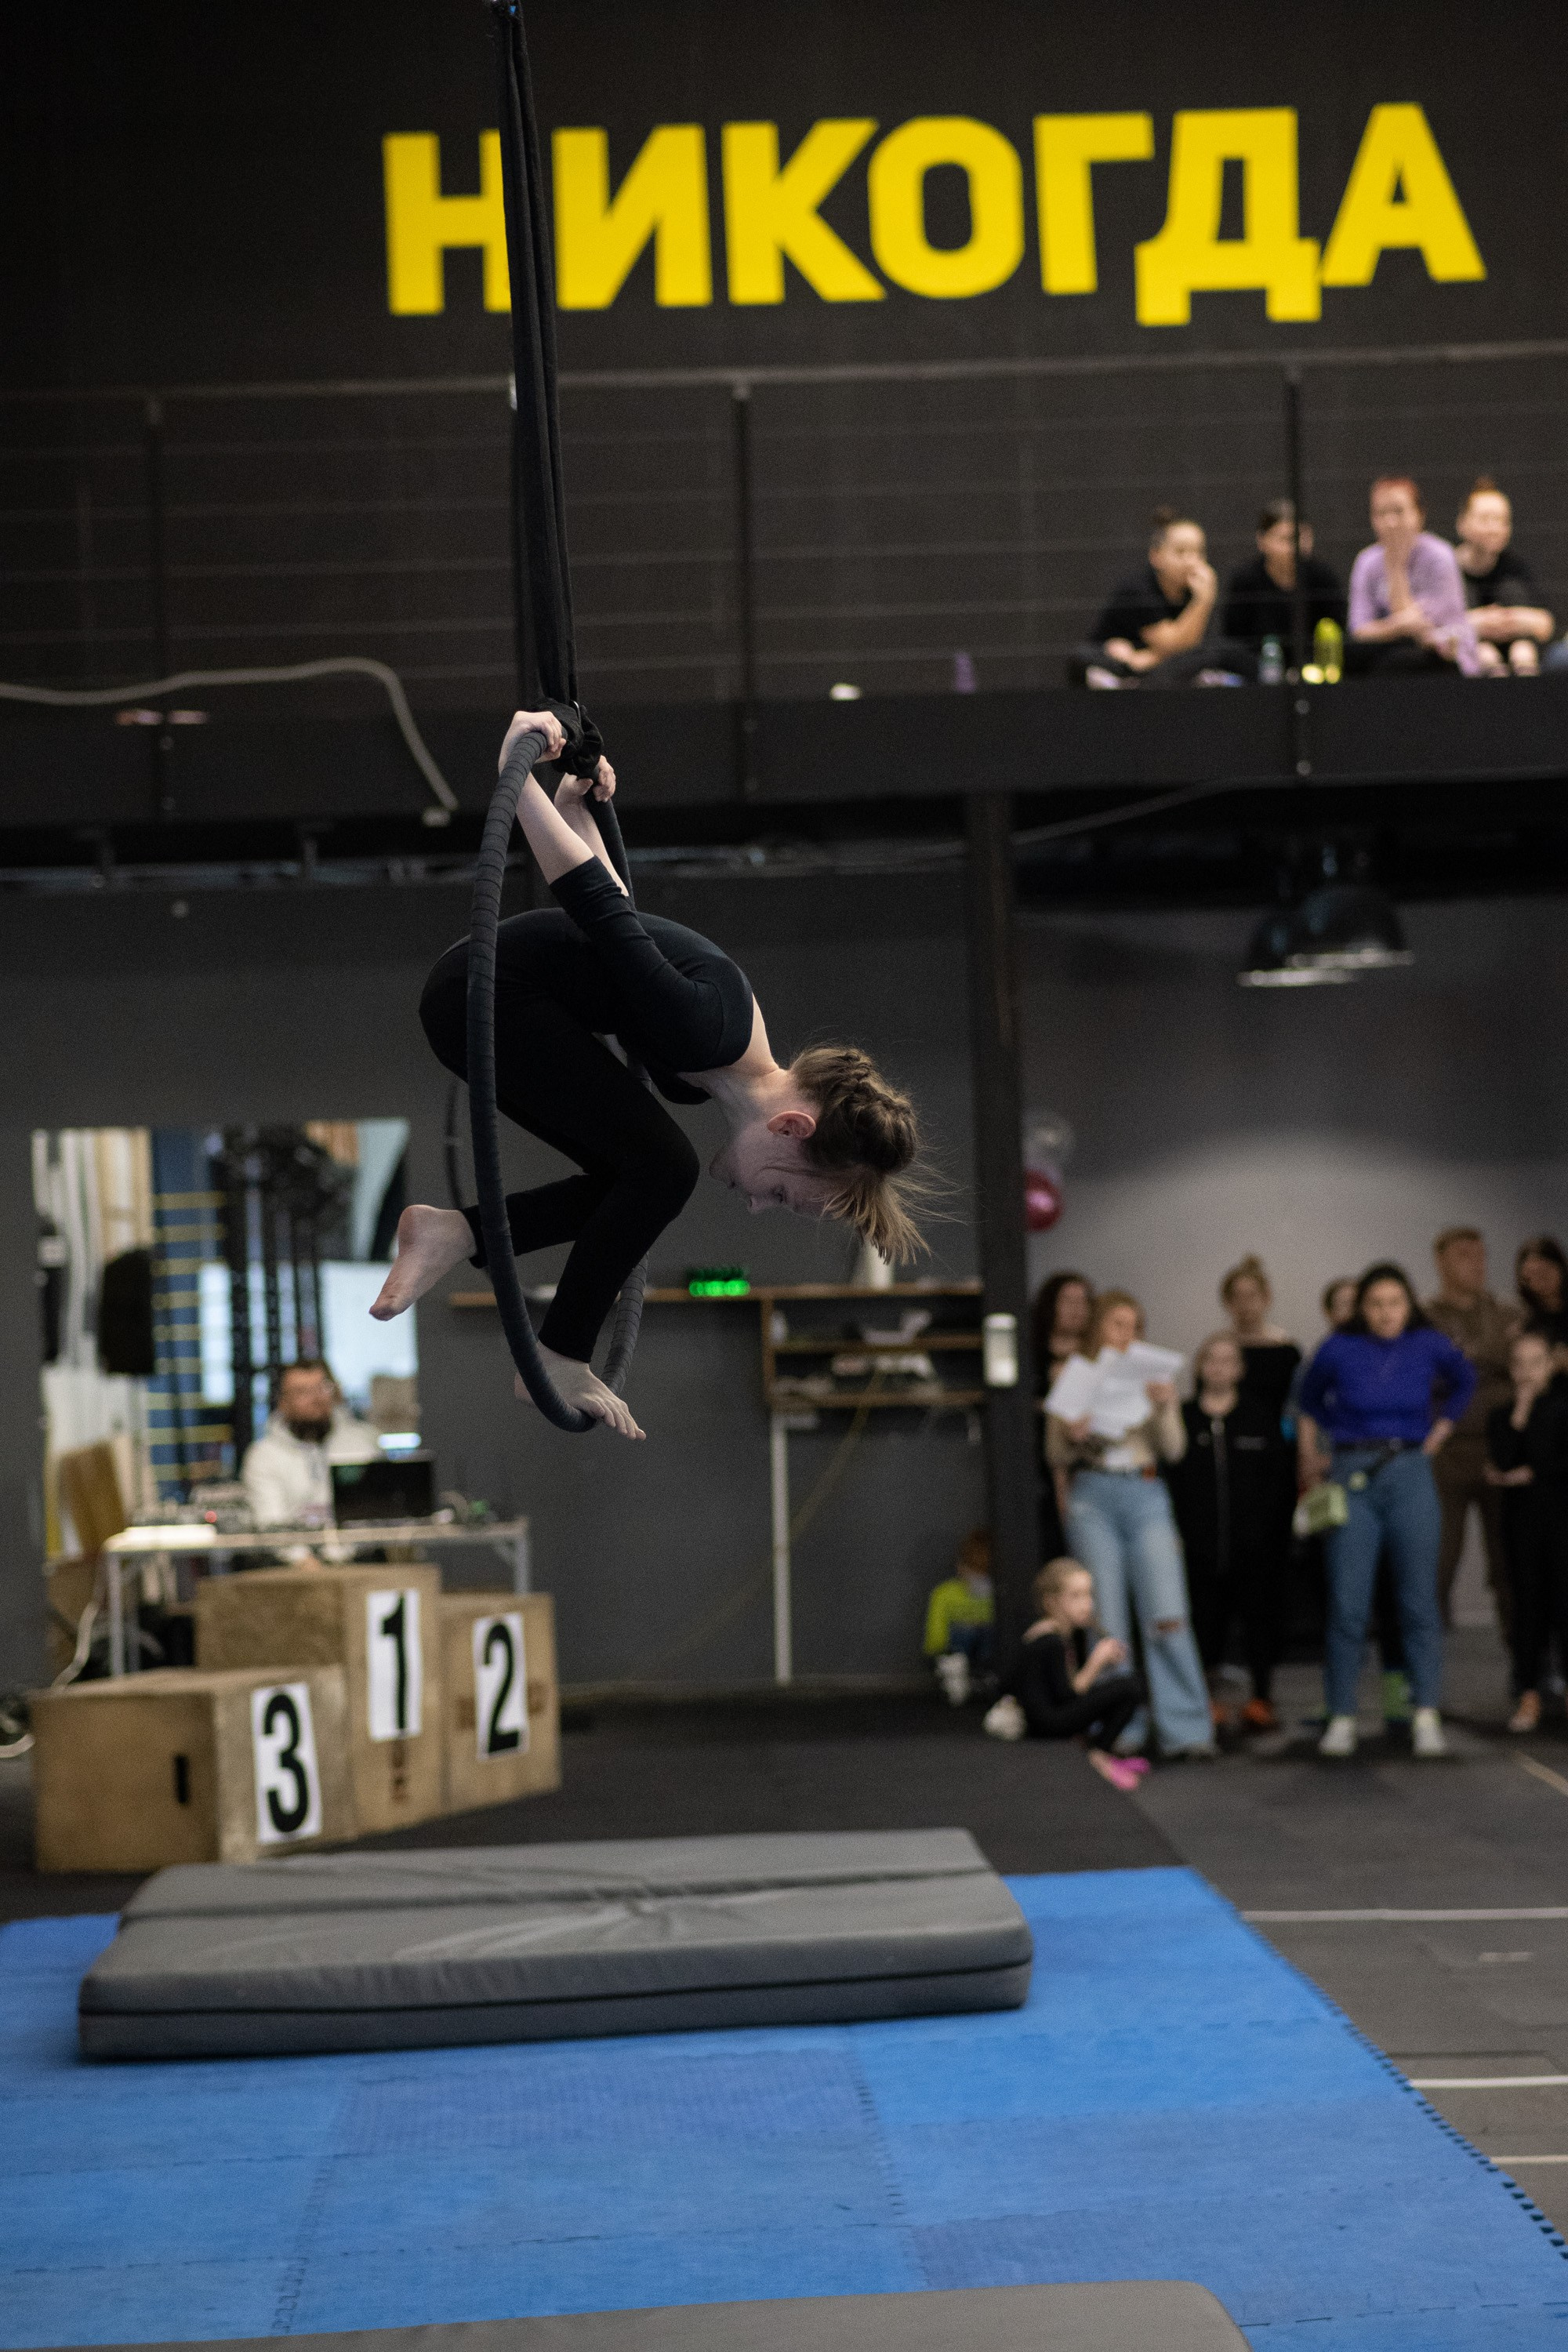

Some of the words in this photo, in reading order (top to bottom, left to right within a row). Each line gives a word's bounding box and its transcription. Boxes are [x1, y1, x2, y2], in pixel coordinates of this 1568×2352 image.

[383, 103, 1487, 327] НИКОГДА
[381, 1592, 407, 1731] 1
[483, 1621, 521, 1755] 2
[263, 1692, 309, 1834] 3
